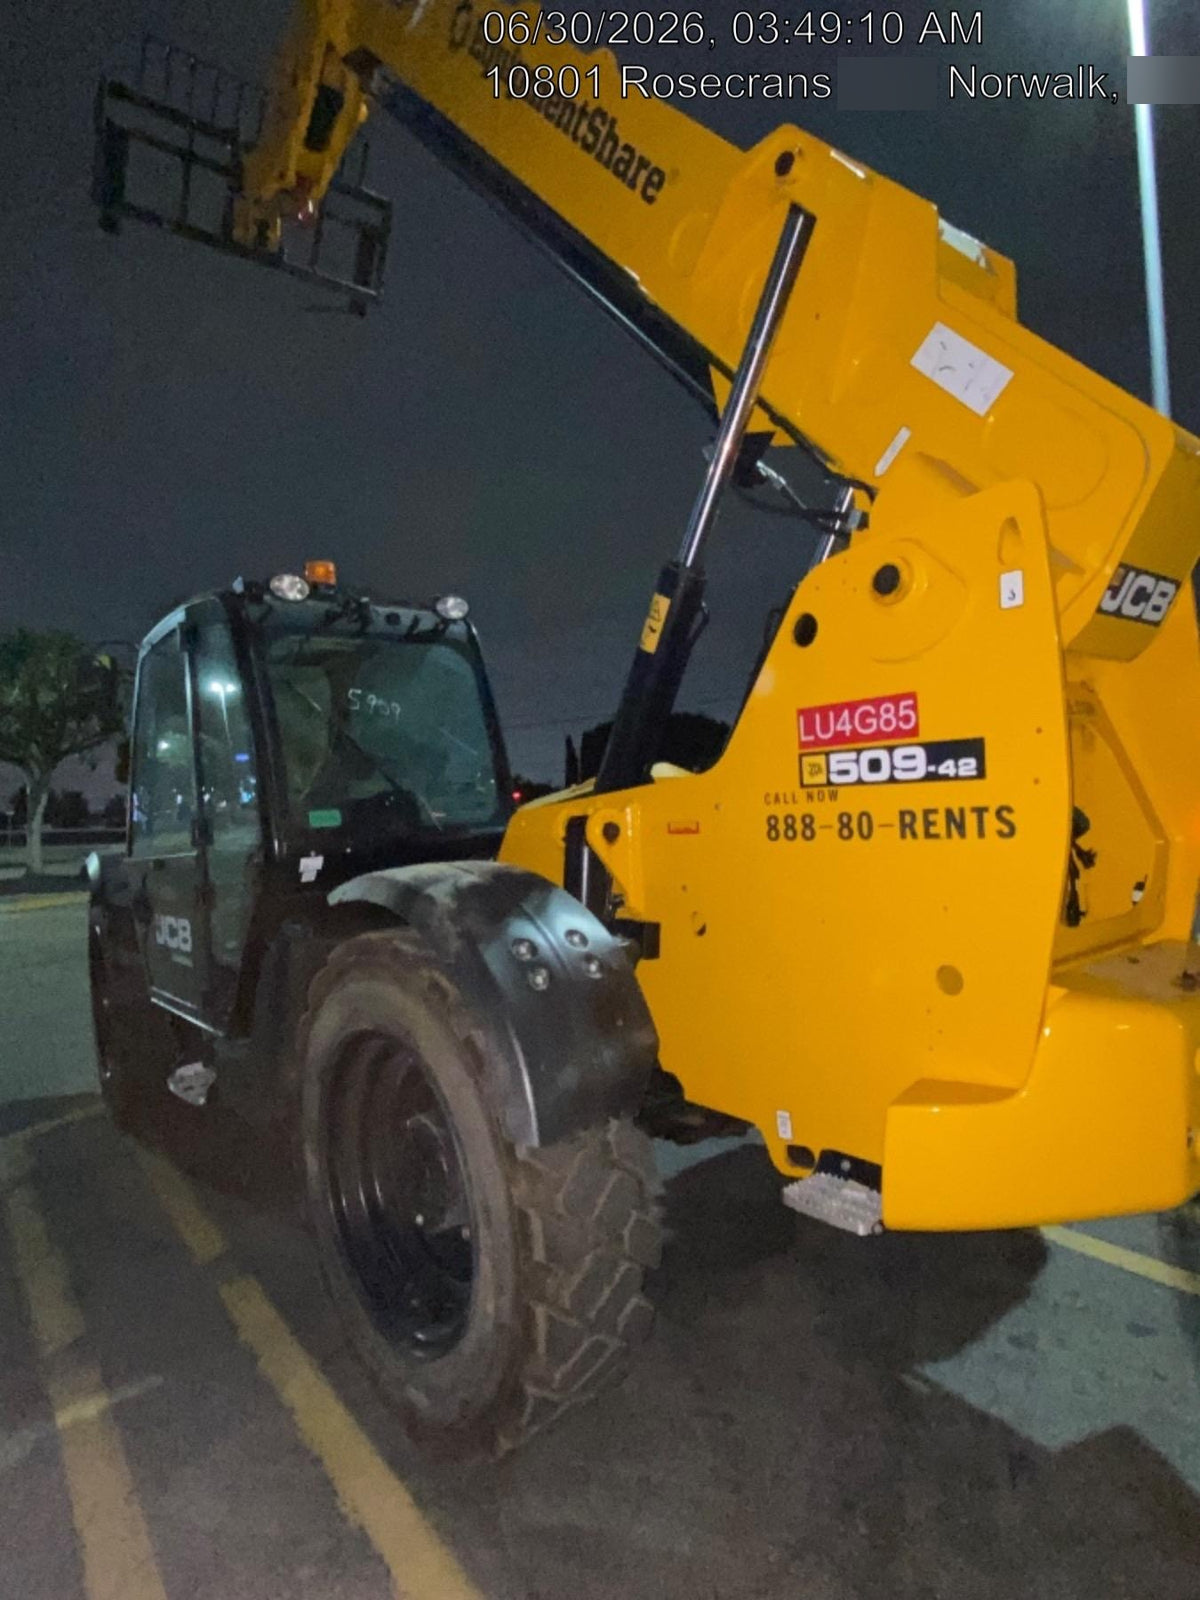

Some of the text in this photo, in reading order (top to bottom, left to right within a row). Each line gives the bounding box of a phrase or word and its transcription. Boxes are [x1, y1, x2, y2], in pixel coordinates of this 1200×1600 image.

[1100, 568, 1177, 622] JCB
[800, 699, 917, 742] LU4G85
[829, 746, 978, 784] 509-42
[764, 789, 838, 806] CALL NOW
[766, 805, 1017, 842] 888-80-RENTS
[155, 914, 192, 952] JCB
